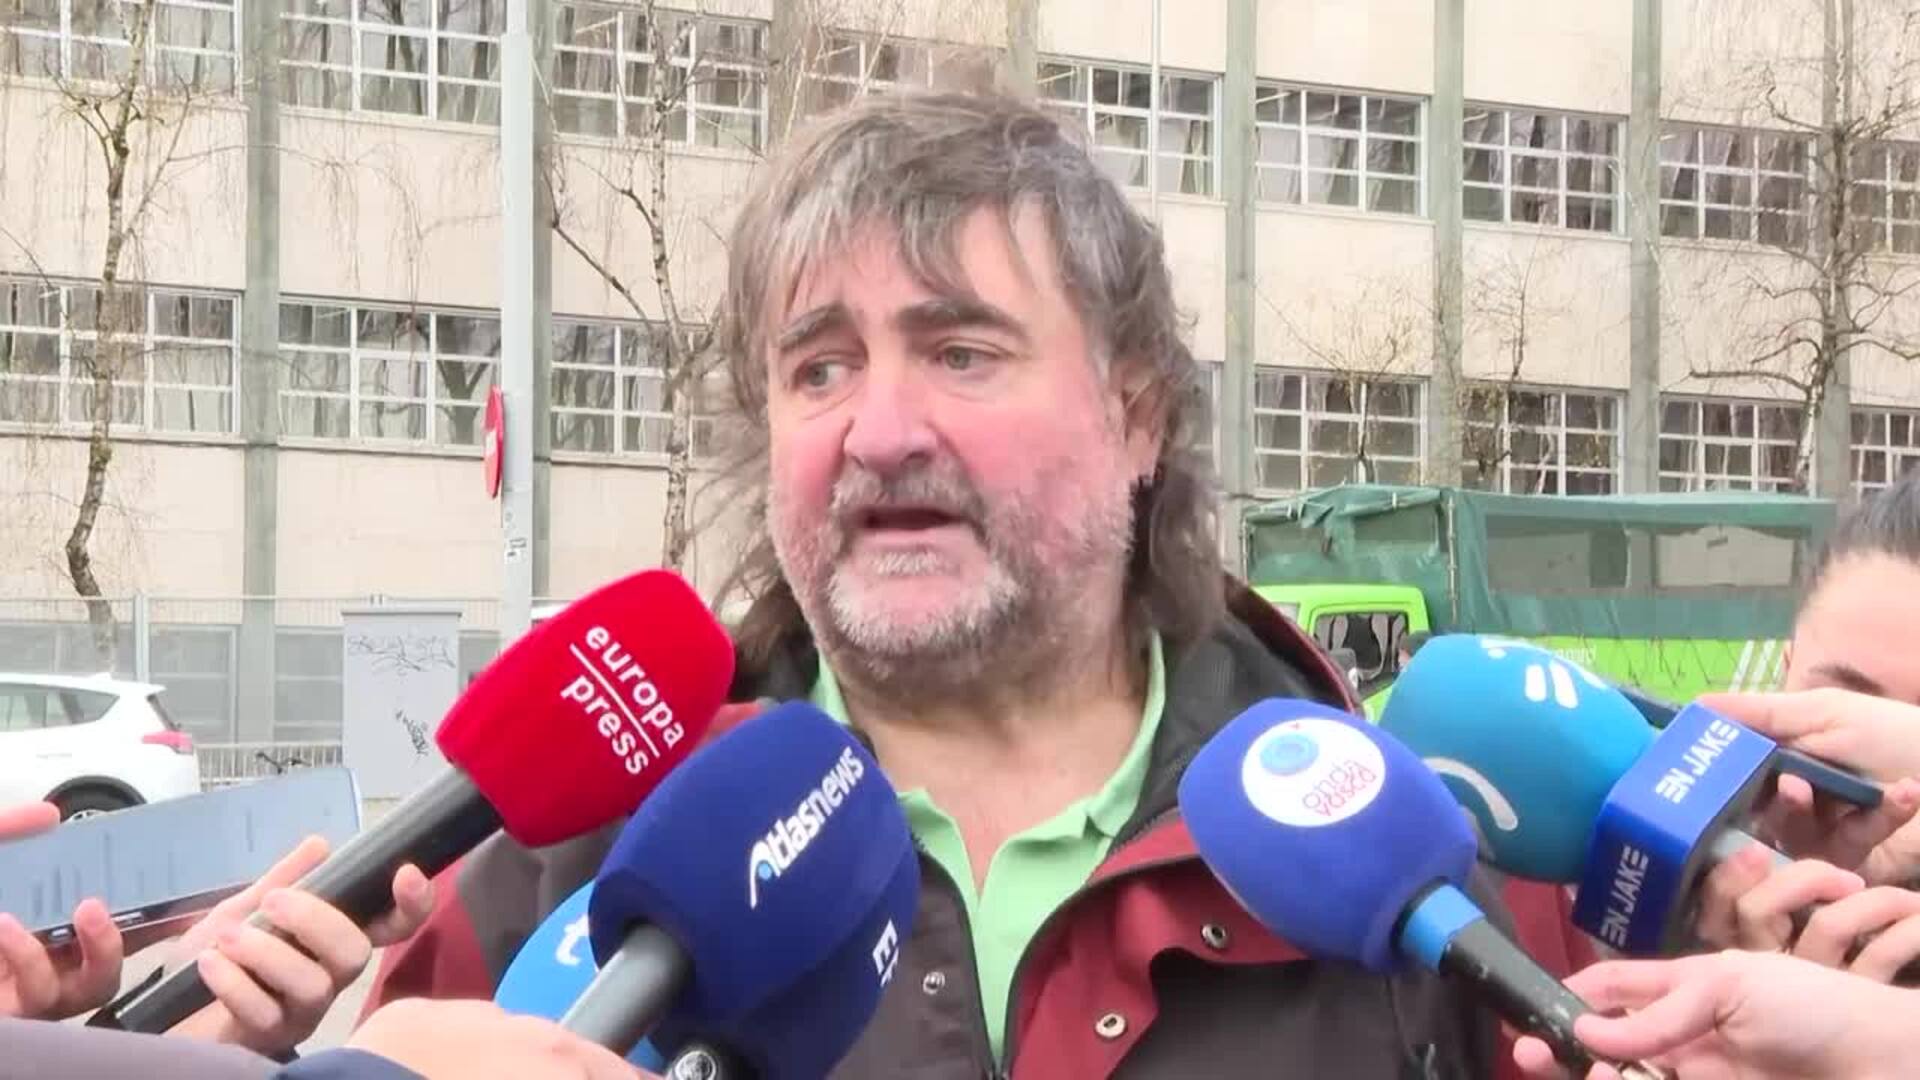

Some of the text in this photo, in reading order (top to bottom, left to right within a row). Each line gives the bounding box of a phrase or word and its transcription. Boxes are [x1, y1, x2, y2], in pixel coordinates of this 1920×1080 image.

[560, 675, 649, 774] press
[585, 626, 685, 749] europa
[1682, 719, 1740, 776] JAKE
[1611, 845, 1649, 914] JAKE
